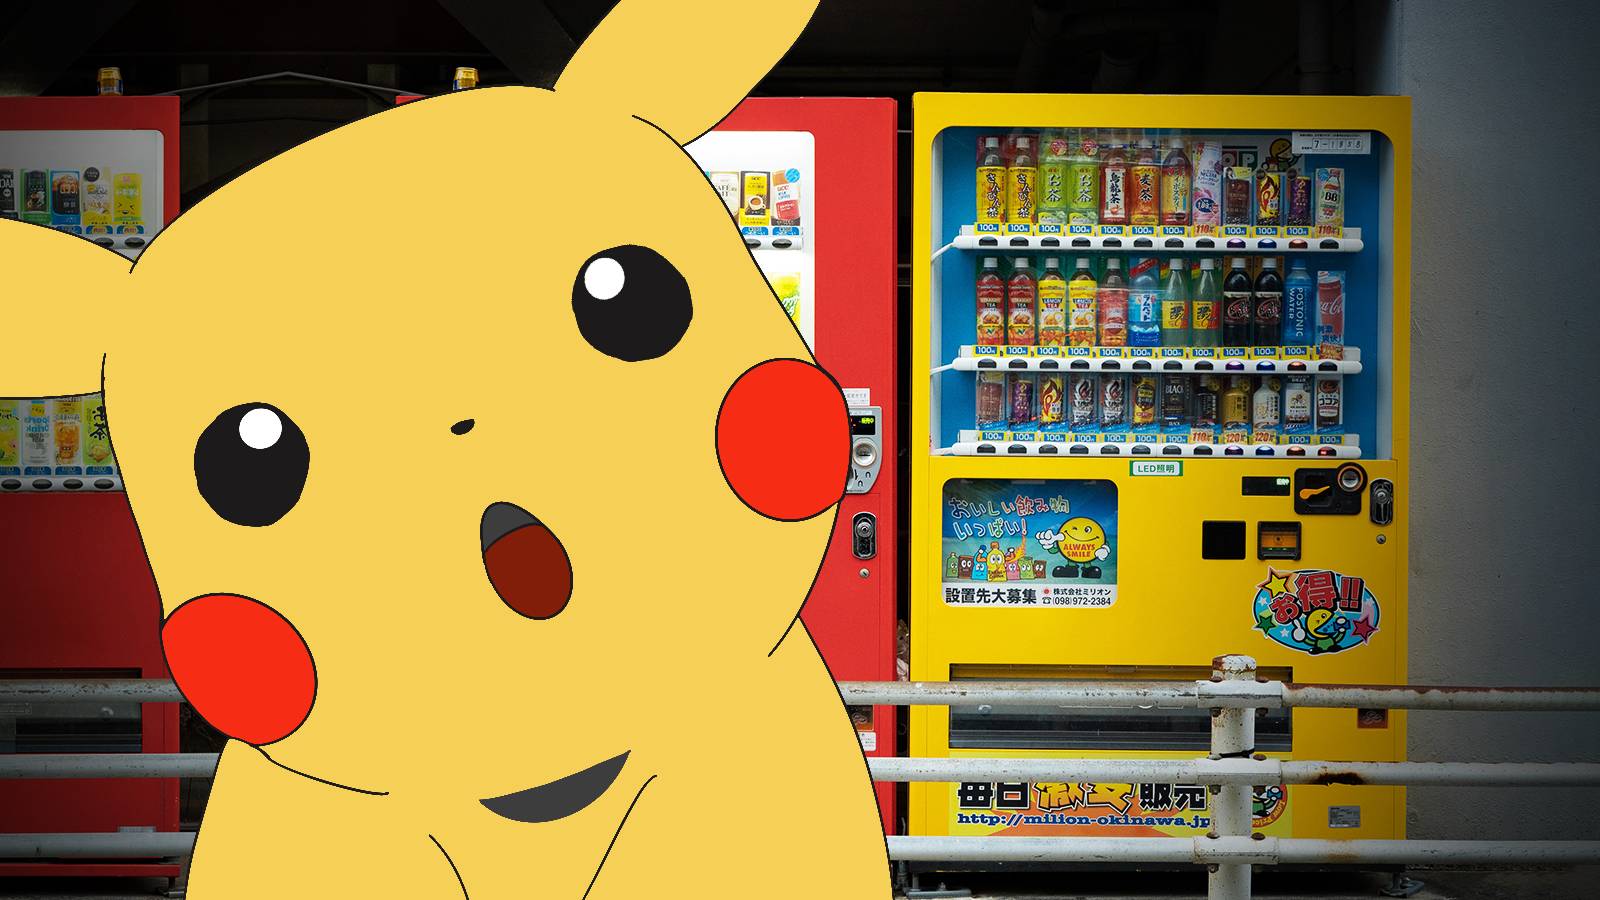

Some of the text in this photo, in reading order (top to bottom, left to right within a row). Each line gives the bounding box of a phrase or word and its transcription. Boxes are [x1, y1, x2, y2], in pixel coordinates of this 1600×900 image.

[1047, 174, 1062, 202] お茶
[1077, 174, 1093, 202] お茶
[1140, 173, 1153, 202] 麦茶
[1319, 397, 1338, 406] ココア
[1138, 465, 1175, 473] LED照明
[949, 495, 1070, 519] おいしい飲み物
[1063, 543, 1095, 551] ALWAYS
[1067, 550, 1091, 558] SMILE
[945, 587, 1037, 604] 設置先大募集
[1053, 587, 1112, 596] 株式会社ミリオン
[1052, 596, 1112, 606] (098)972-2384
[957, 813, 1211, 828] http://milion-okinawa.jp
